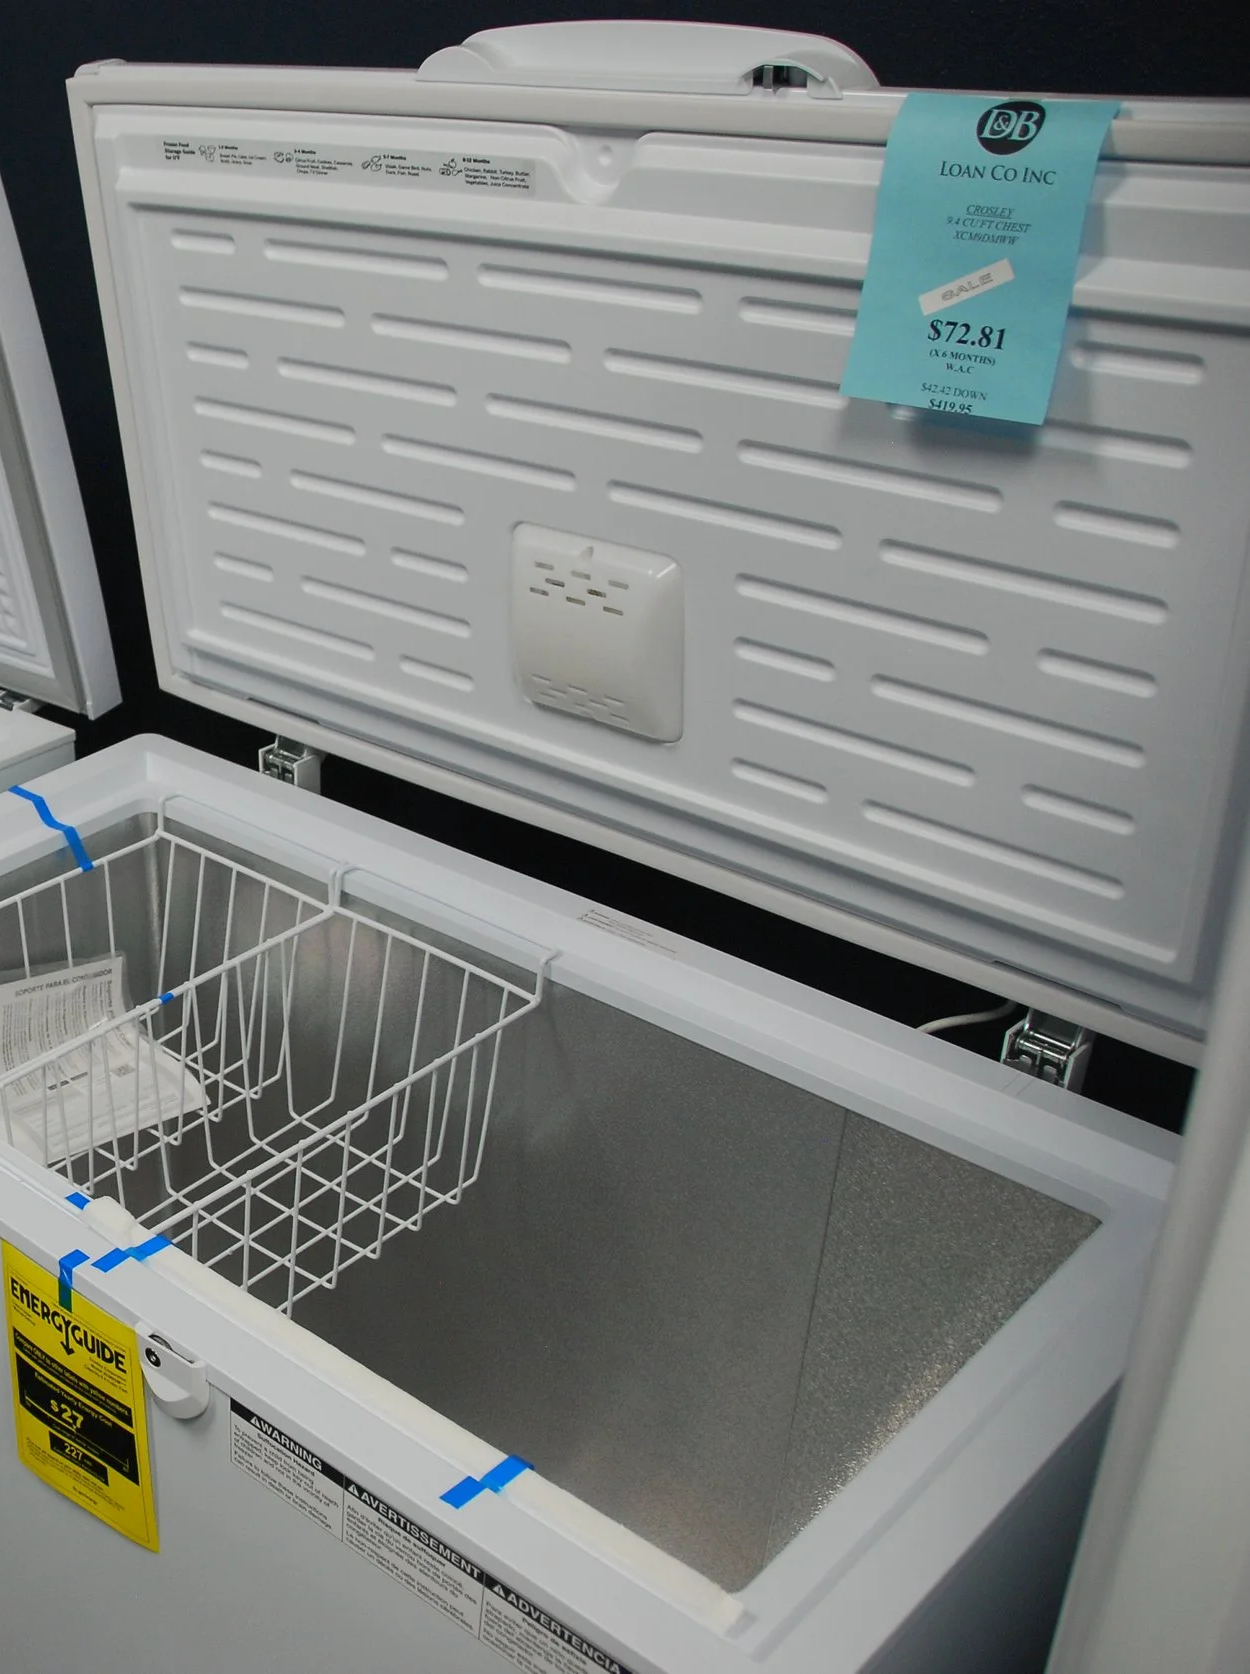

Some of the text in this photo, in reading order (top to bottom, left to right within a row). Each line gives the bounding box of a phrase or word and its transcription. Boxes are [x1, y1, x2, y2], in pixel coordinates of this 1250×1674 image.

[966, 205, 1015, 219] CROSLEY
[995, 221, 1032, 233] CHEST
[942, 273, 994, 301] SALE
[928, 319, 1006, 350] $72.81
[950, 351, 996, 366] MONTHS)
[953, 388, 987, 400] DOWN
[11, 1276, 127, 1375] ENERGYGUIDE
[63, 1441, 83, 1461] 227
[260, 1419, 321, 1471] WARNING
[293, 1456, 314, 1477] Hazard
[360, 1489, 480, 1581] AVERTISSEMENT
[507, 1594, 621, 1673] ADVERTENCIA
